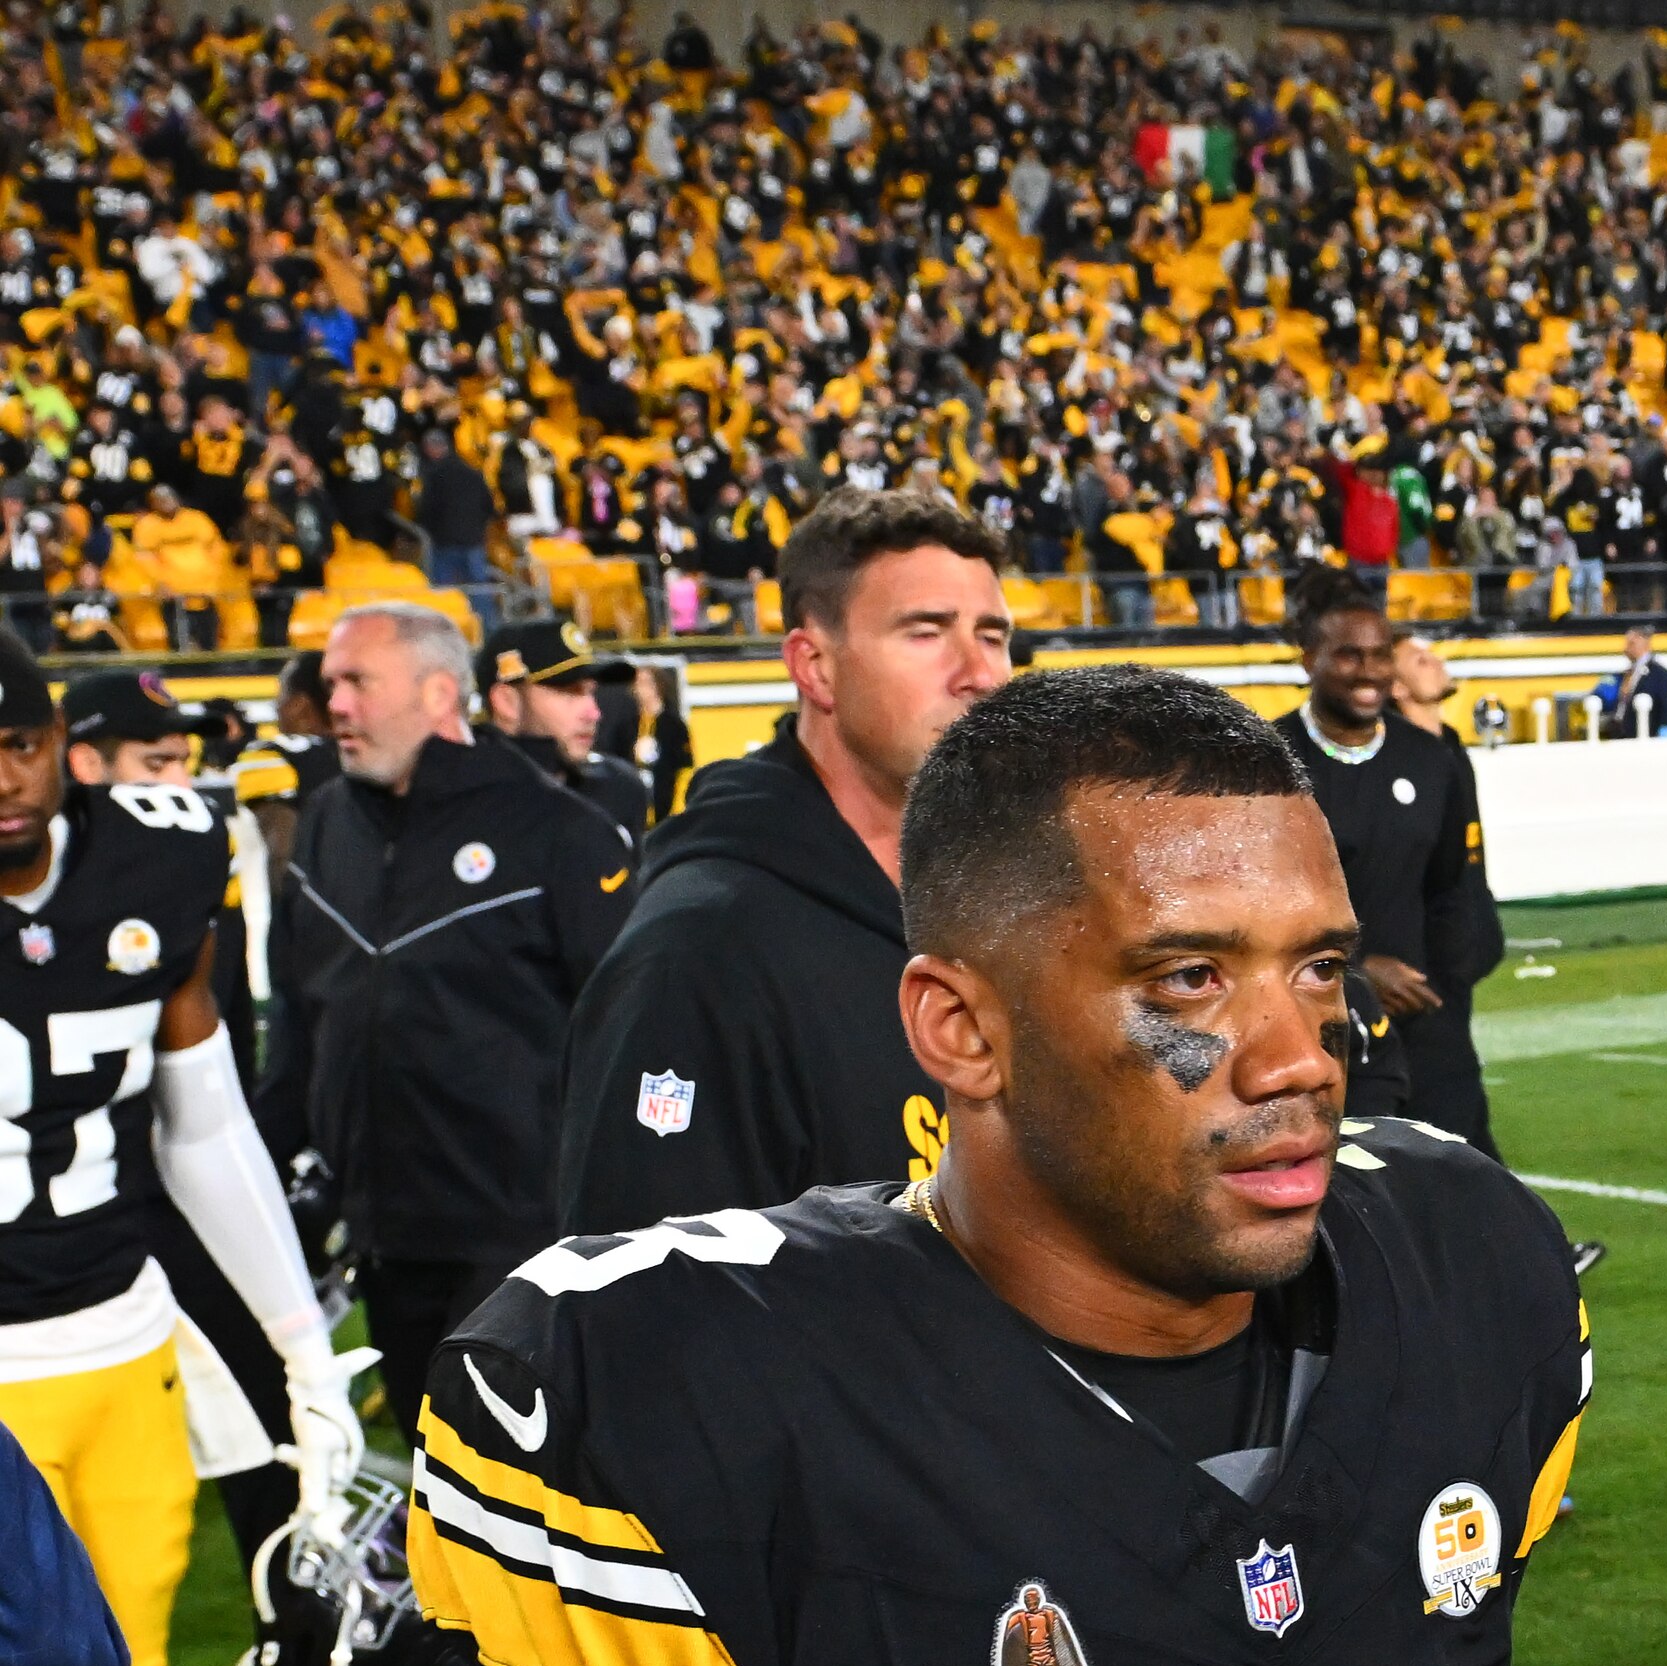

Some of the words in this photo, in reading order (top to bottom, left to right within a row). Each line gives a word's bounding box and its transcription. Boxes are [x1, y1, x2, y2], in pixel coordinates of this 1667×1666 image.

[647, 1096, 683, 1124] NFL
[1434, 1510, 1485, 1560] 50
[1432, 1566, 1465, 1590] SUPER
[1465, 1557, 1493, 1577] BOWL
[1254, 1581, 1297, 1620] NFL
[1453, 1576, 1483, 1609] IX
